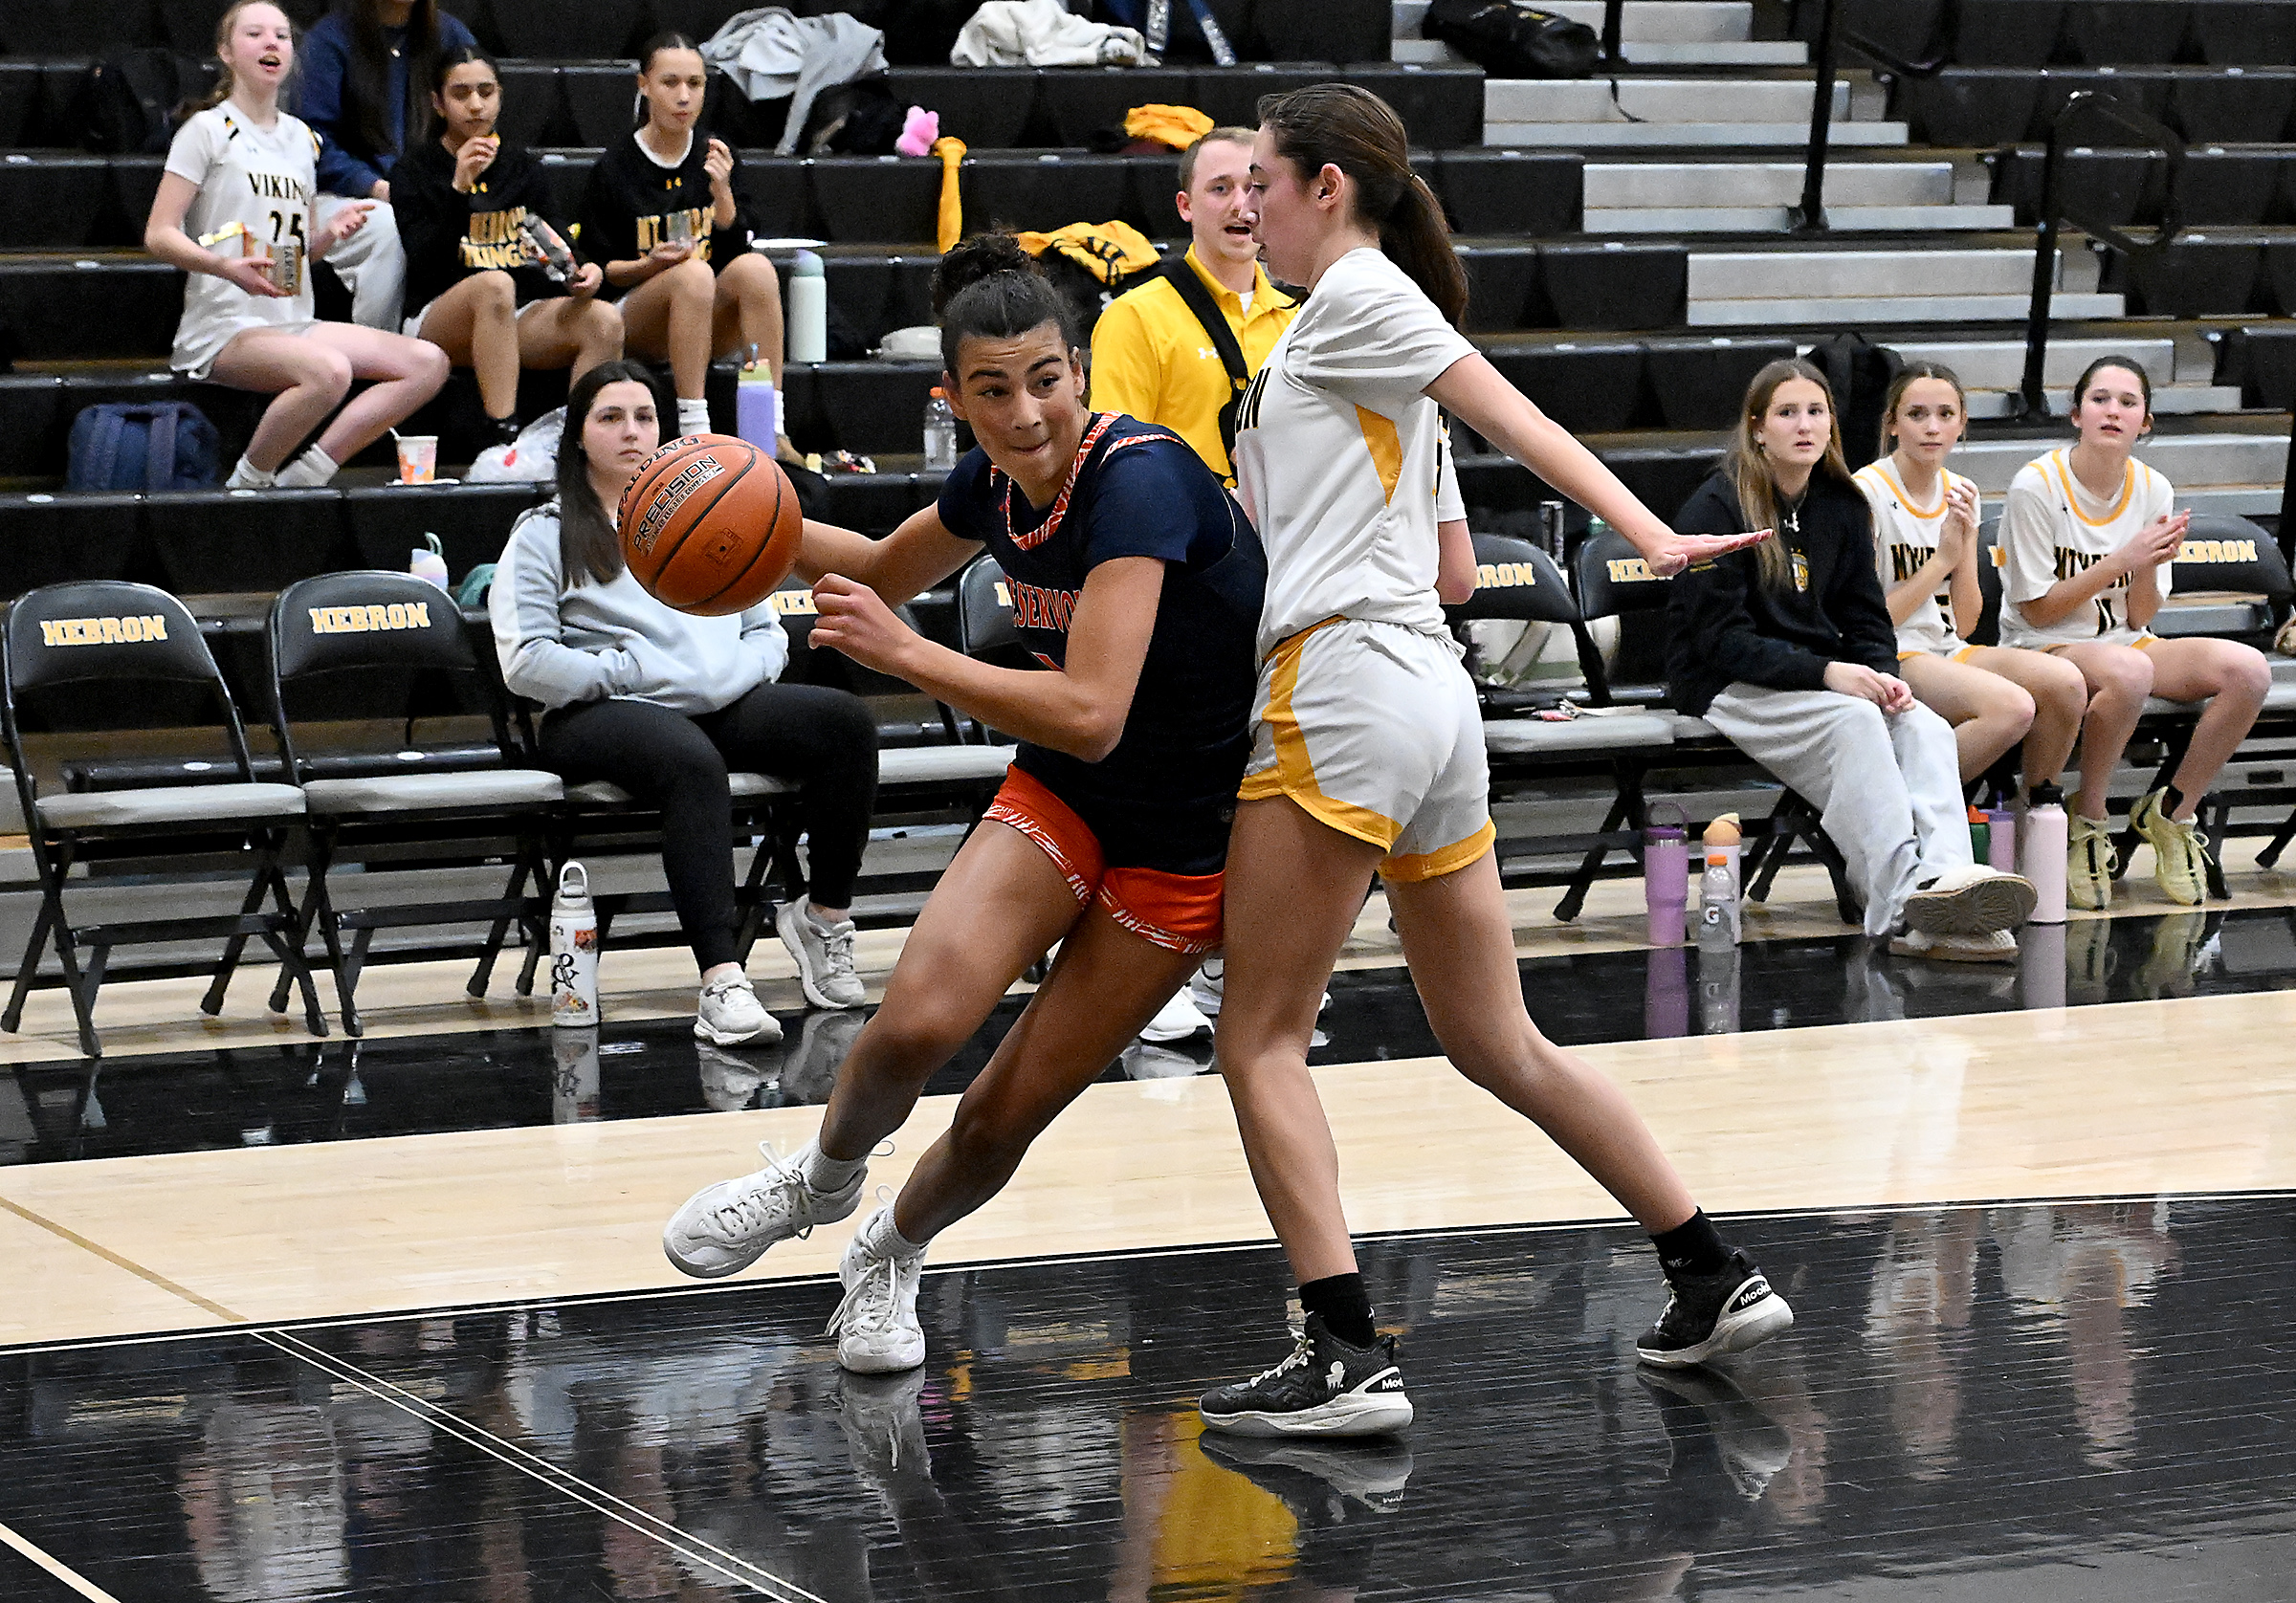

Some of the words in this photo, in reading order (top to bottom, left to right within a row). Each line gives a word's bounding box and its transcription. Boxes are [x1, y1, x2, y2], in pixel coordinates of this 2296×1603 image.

[247, 171, 307, 206] VIKIN
[616, 436, 699, 532] PALDING
[633, 454, 720, 553] PRECISION
[1475, 562, 1535, 589] RON
[40, 615, 167, 647] HEBRON
[308, 602, 430, 633] HEBRON
